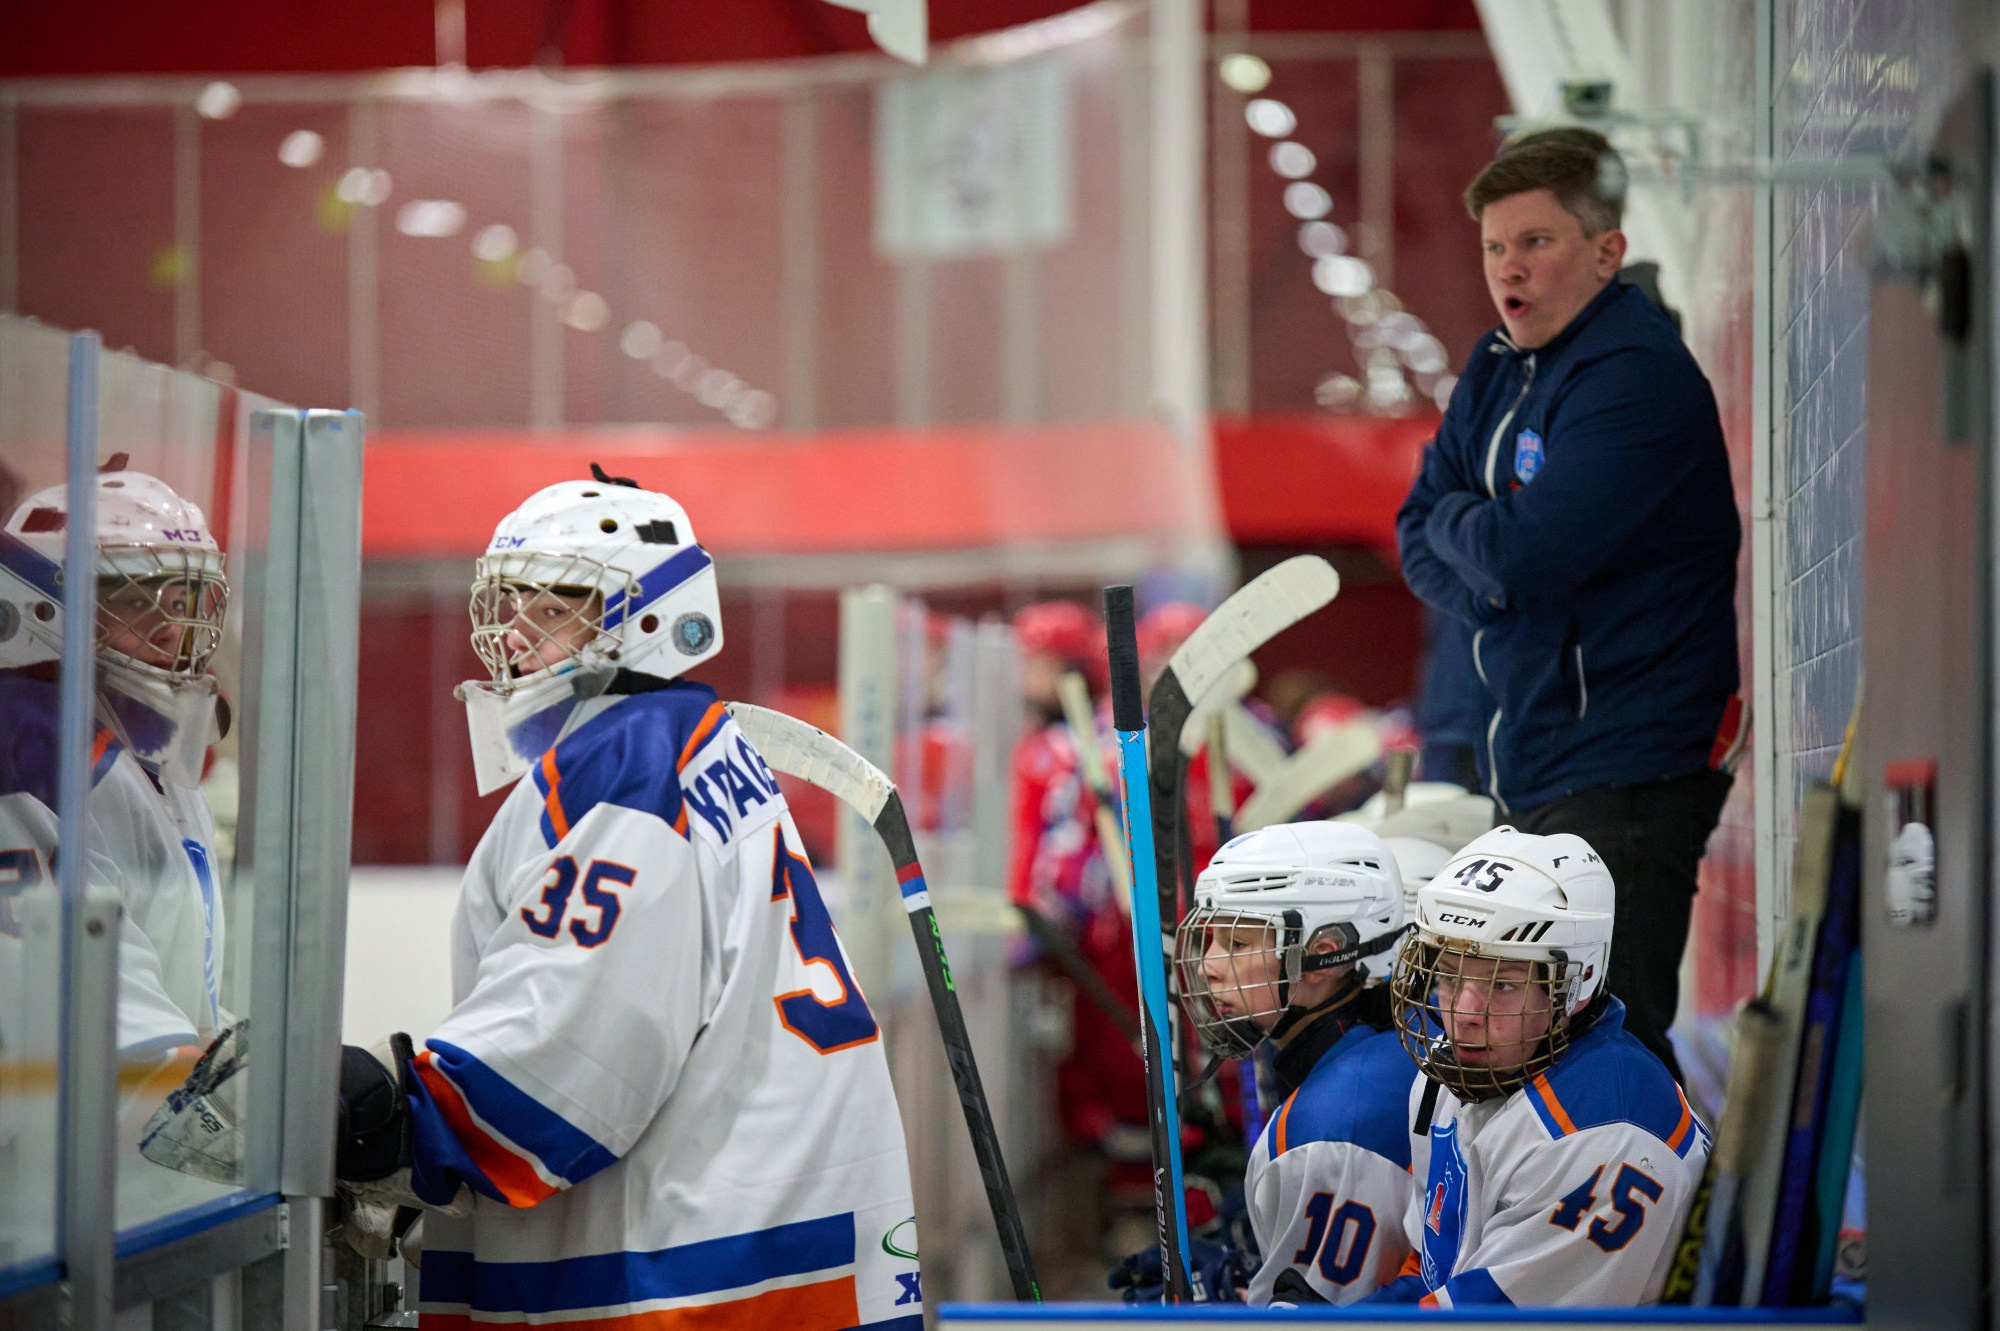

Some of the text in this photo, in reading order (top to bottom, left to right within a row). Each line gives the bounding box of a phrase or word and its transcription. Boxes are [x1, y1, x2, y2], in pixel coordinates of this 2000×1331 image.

[520, 854, 638, 950] 35
[1439, 912, 1487, 929] CCM
[1454, 859, 1514, 893] 45
[1293, 1191, 1377, 1287] 10
[1550, 1162, 1664, 1253] 45
